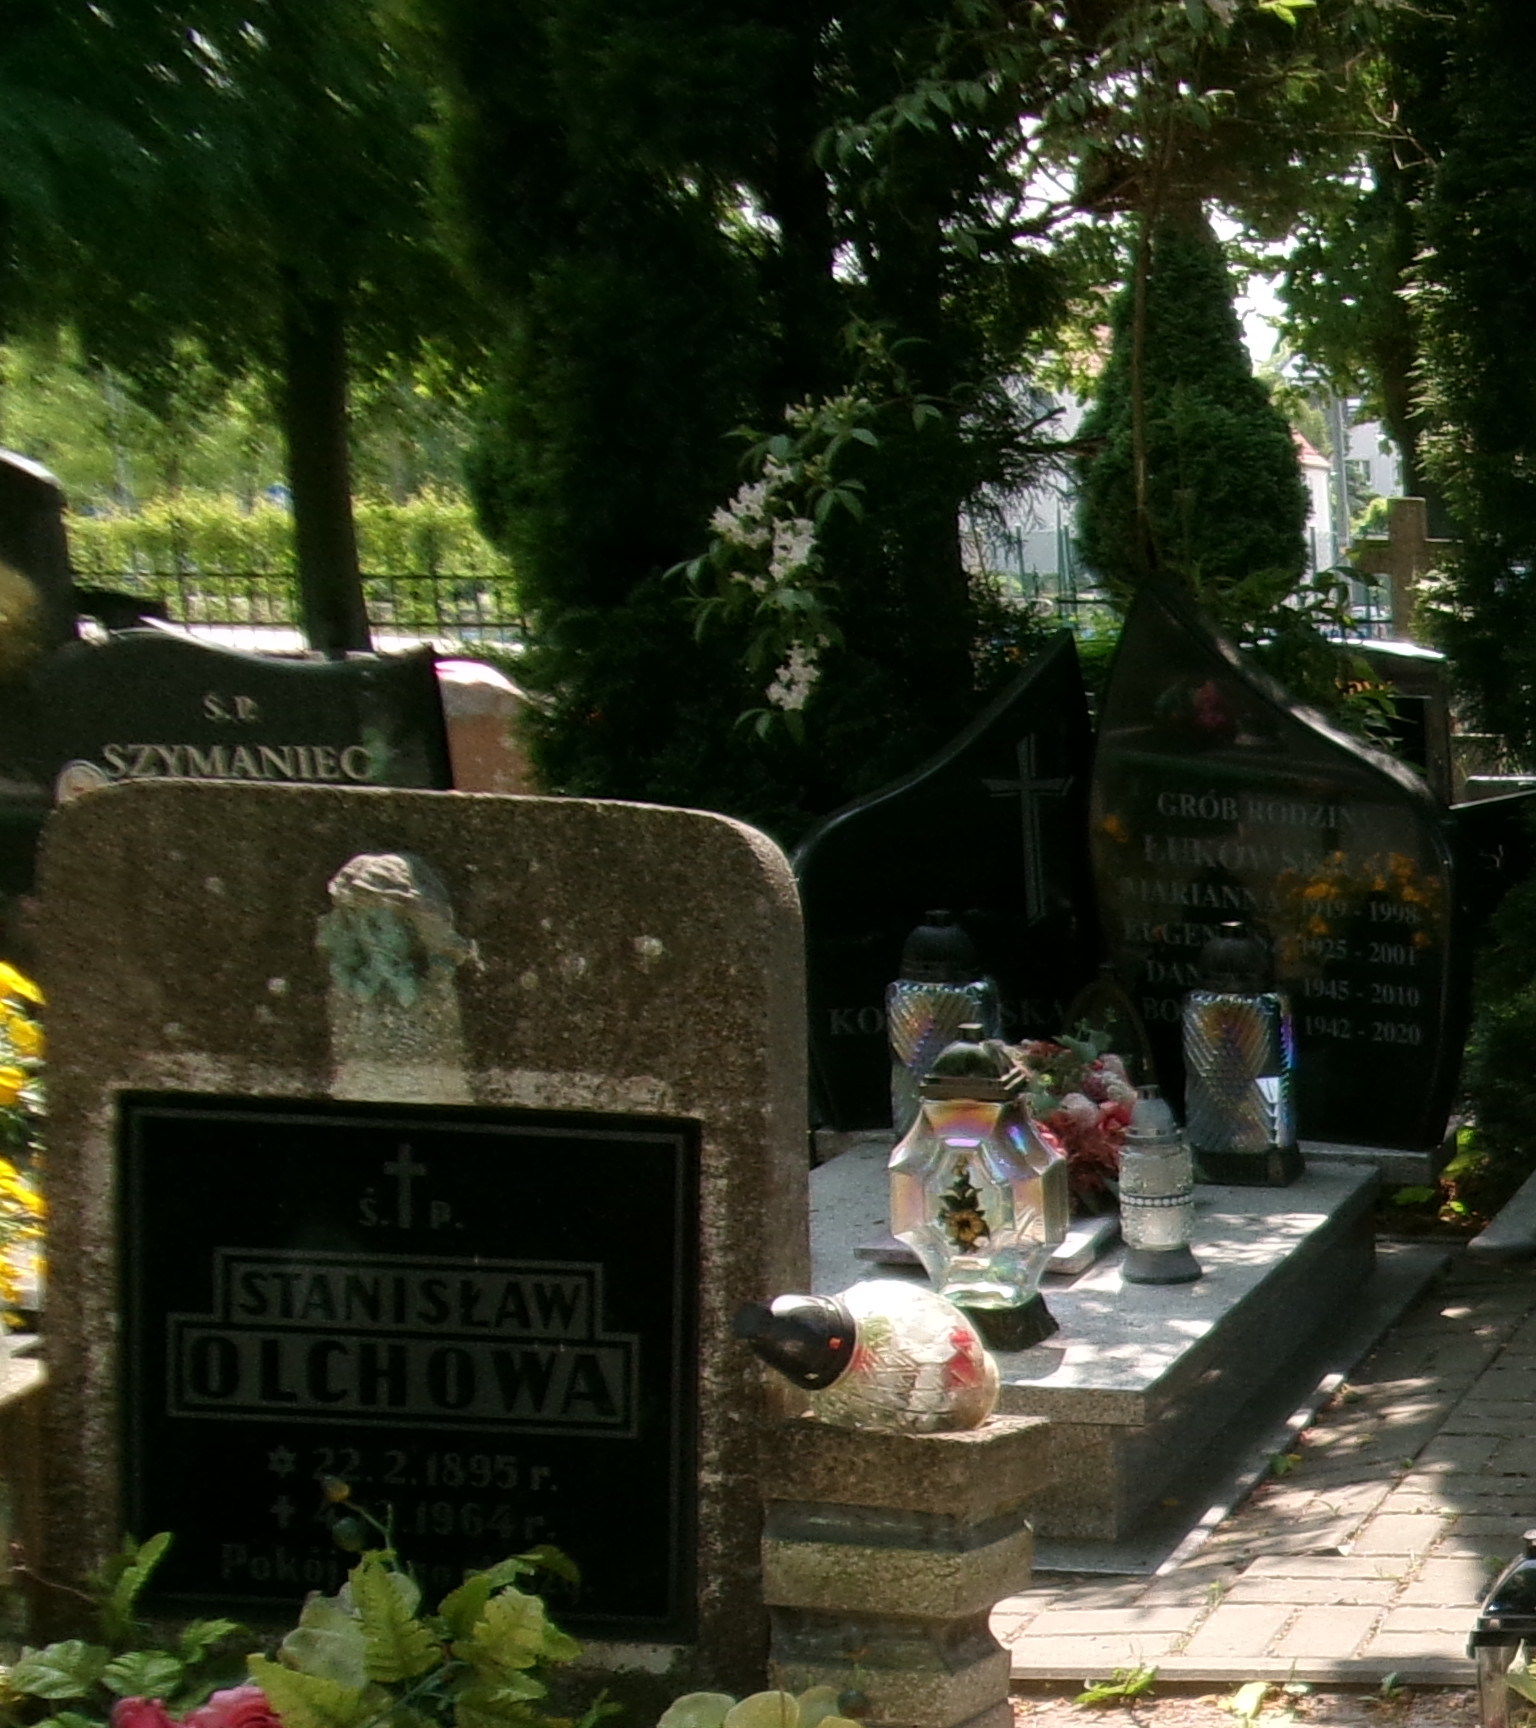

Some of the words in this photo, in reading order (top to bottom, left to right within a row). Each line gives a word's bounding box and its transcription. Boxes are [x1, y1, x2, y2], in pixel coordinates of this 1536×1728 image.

[101, 743, 374, 783] SZYMANIEC
[238, 1270, 584, 1331] STANISŁAW
[190, 1335, 618, 1417] OLCHOWA
